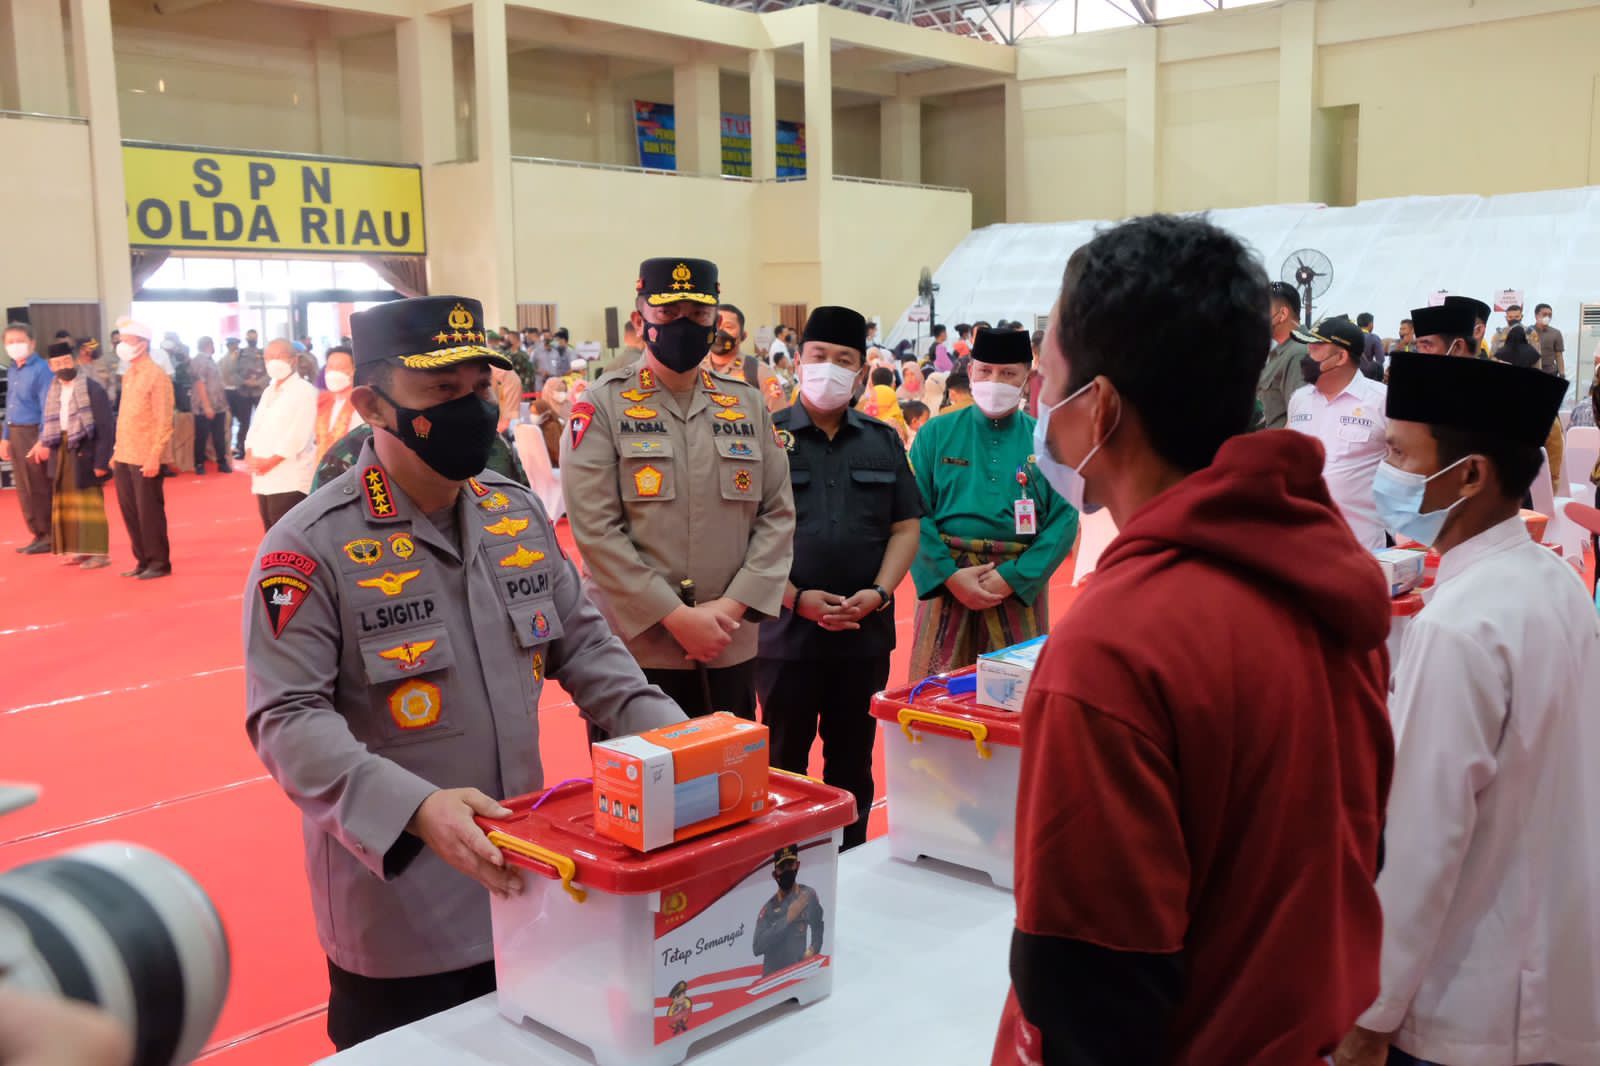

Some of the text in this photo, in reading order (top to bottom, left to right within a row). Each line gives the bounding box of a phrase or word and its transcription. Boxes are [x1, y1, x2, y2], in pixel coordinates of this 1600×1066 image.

[126, 198, 411, 247] OLDA RIAU
[712, 423, 755, 436] POLRI
[506, 572, 549, 599] POLRI
[661, 923, 745, 967] Tetap Semangat
